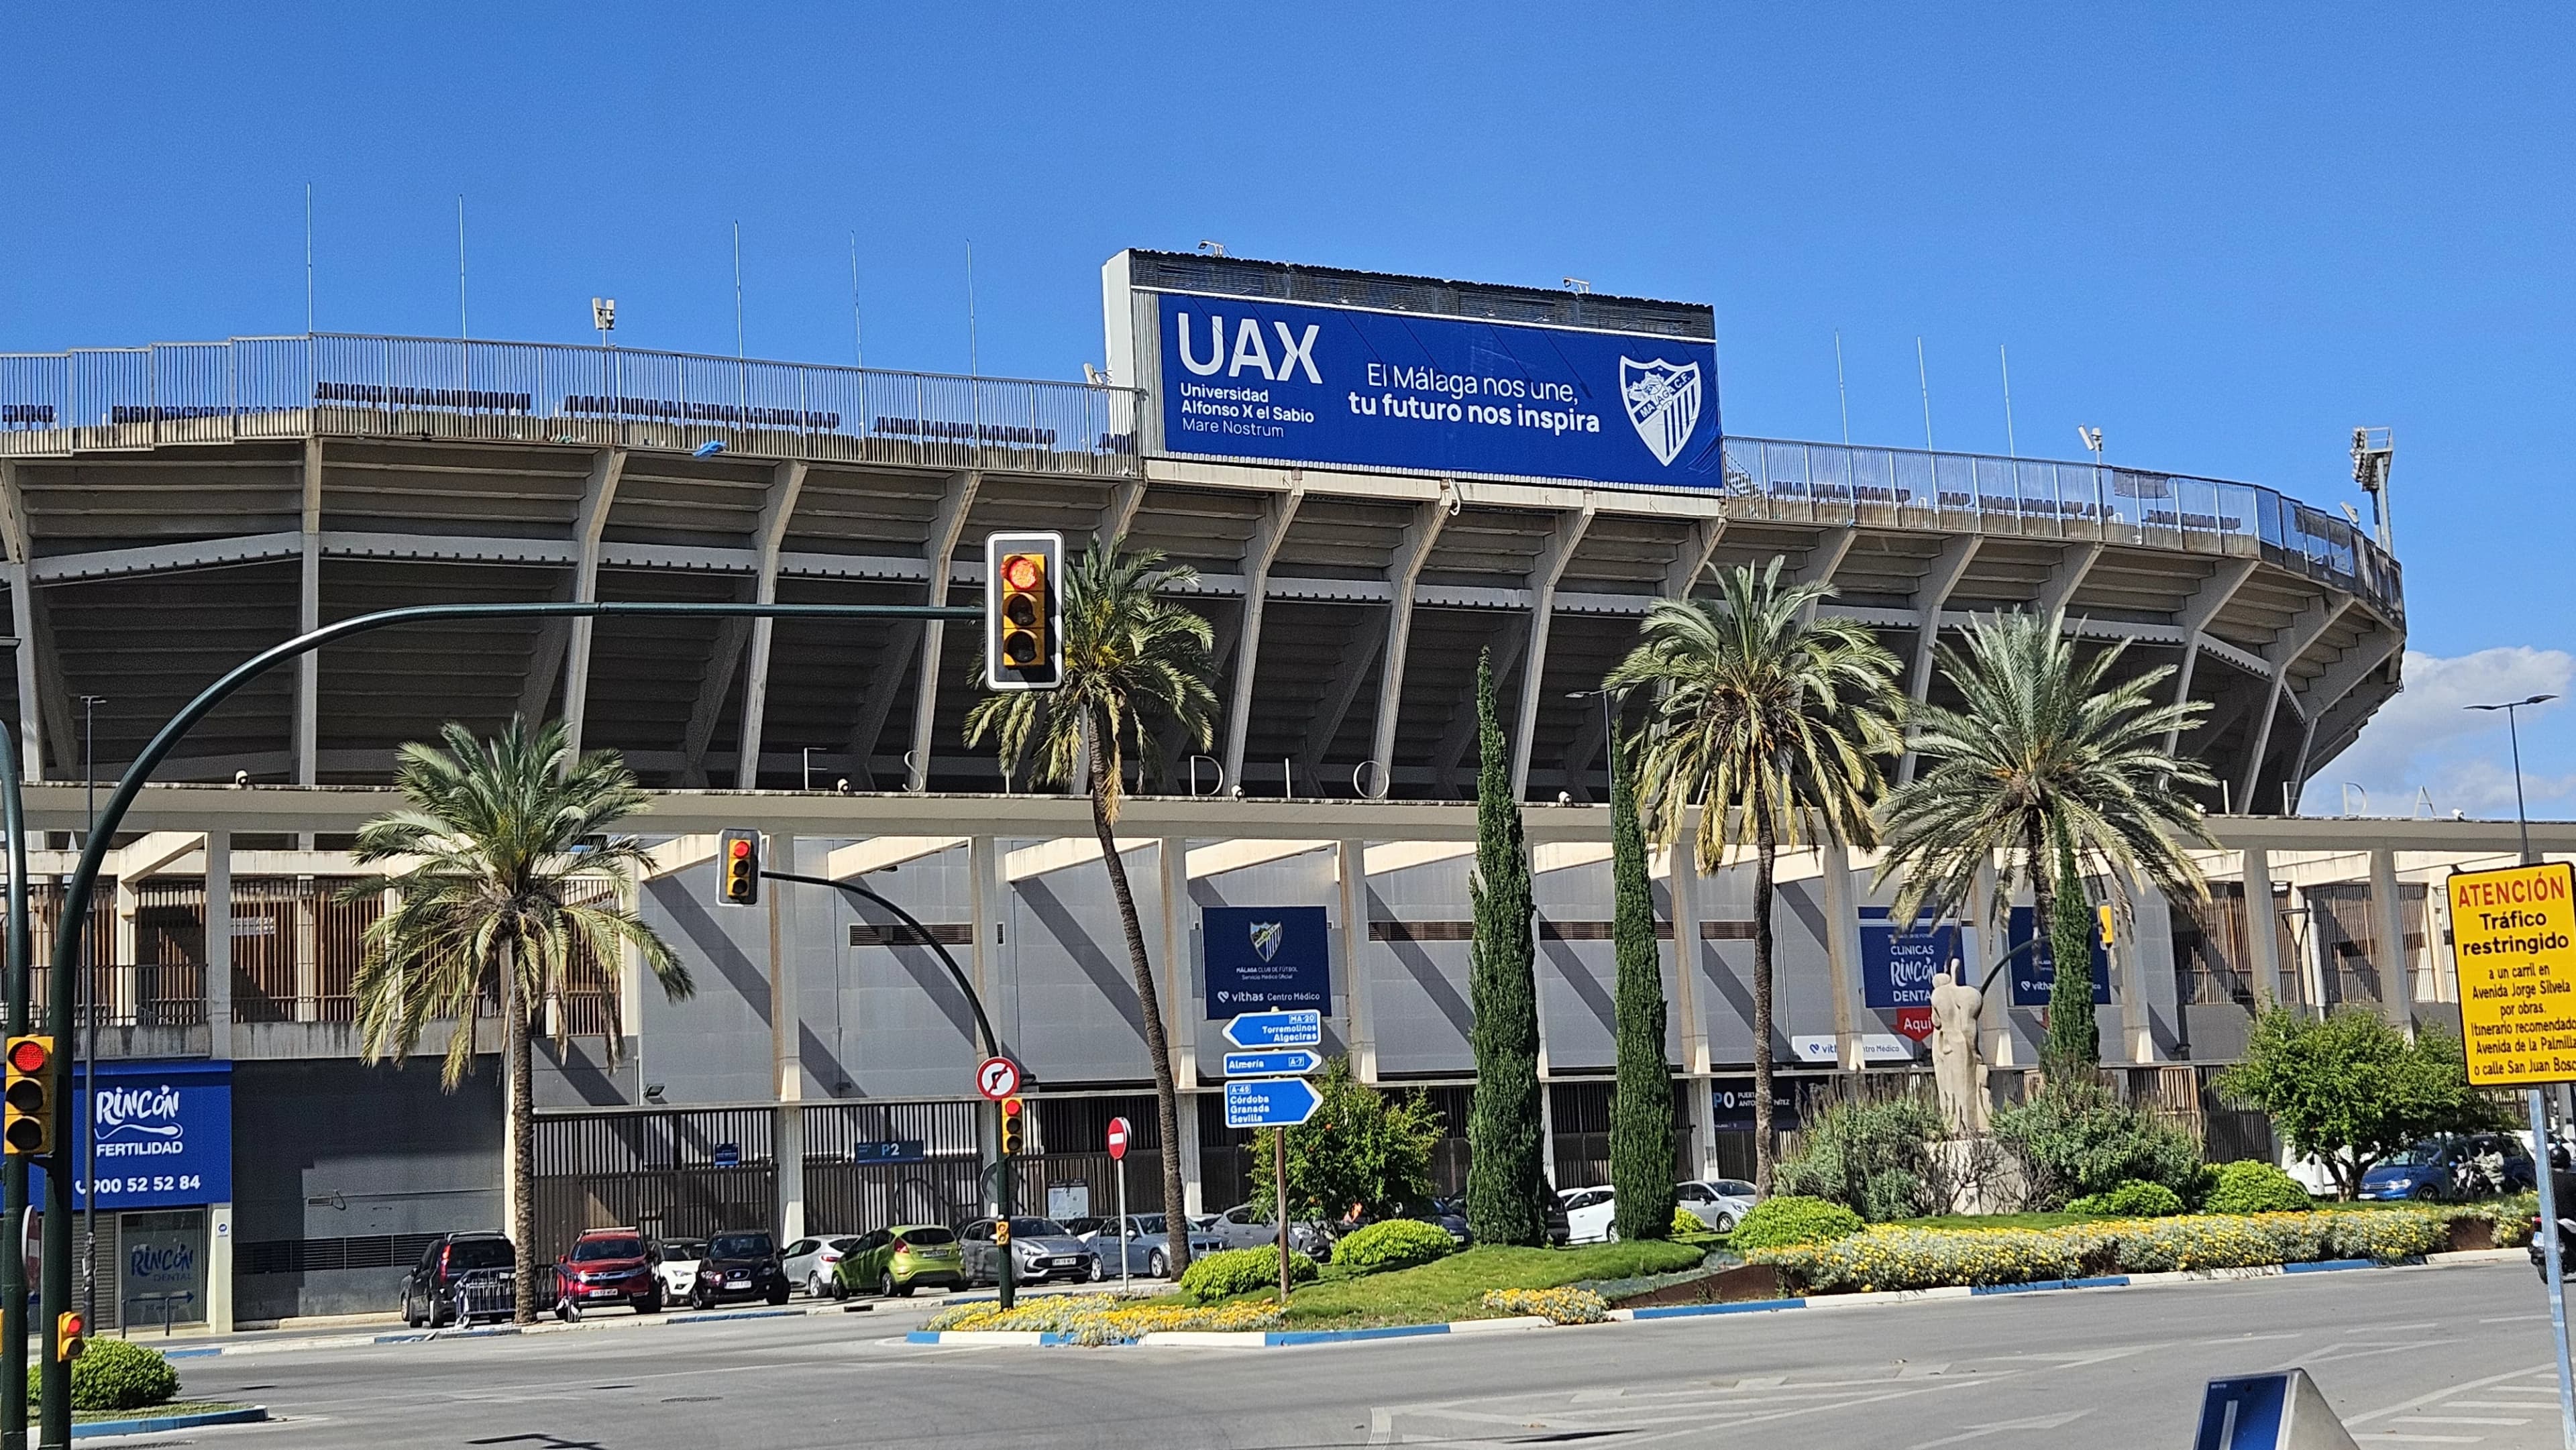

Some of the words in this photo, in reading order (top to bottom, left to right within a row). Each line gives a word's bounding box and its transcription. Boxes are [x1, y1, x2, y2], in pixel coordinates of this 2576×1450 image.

[1178, 313, 1323, 384] UAX
[1181, 382, 1269, 402] Universidad
[1368, 363, 1387, 387] El
[1393, 365, 1477, 400] Málaga
[1483, 377, 1525, 398] nos
[1531, 382, 1578, 405] une,
[1181, 400, 1239, 417] Alfonso
[1242, 404, 1253, 419] X
[1256, 406, 1270, 420] el
[1273, 406, 1314, 423] Sabio
[1348, 392, 1377, 415] tu
[1383, 393, 1462, 422] futuro
[1468, 404, 1511, 425] nos
[1517, 404, 1600, 436] inspira
[1182, 417, 1219, 433] Mare
[1223, 421, 1284, 437] Nostrum
[2459, 872, 2565, 908] ATENCIÓN
[2479, 910, 2547, 931] Tráfico
[1890, 944, 1934, 955] CLINICAS
[2463, 932, 2569, 956] restringido
[1890, 956, 1937, 987] RINCÓN
[2489, 969, 2494, 980] a
[2497, 967, 2509, 979] un
[2512, 962, 2536, 979] carril
[2538, 964, 2550, 977] en
[1232, 991, 1263, 1003] vithas
[1267, 993, 1293, 1001] Centro
[1293, 991, 1320, 1001] Médico
[1892, 990, 1931, 1002] DENTA
[2473, 984, 2508, 1000] Avenida
[2512, 983, 2536, 999] Jorge
[2540, 979, 2571, 995] Silvela
[2500, 1005, 2514, 1020] por
[2518, 1001, 2546, 1015] obras.
[1262, 1025, 1317, 1034] Torremolinos
[2471, 1020, 2512, 1037] Itinerario
[2515, 1016, 2576, 1034] recomendado
[1273, 1032, 1317, 1042] Algeciras
[2476, 1039, 2512, 1056] Avenida
[2515, 1038, 2526, 1052] de
[2528, 1037, 2537, 1052] la
[2540, 1035, 2576, 1052] Palmilla
[1228, 1059, 1265, 1070] Almería
[2474, 1065, 2480, 1076] o
[2482, 1062, 2505, 1076] calle
[2508, 1060, 2526, 1074] San
[2530, 1058, 2551, 1073] Juan
[96, 1084, 179, 1125] RINCÓN
[1230, 1095, 1270, 1104] Córdoba
[1230, 1104, 1270, 1113] Granada
[1230, 1113, 1263, 1123] Sevilla
[96, 1141, 182, 1157] FERTILIDAD
[881, 1143, 900, 1156] P2
[127, 1177, 148, 1192] 52
[153, 1176, 174, 1191] 52
[179, 1174, 201, 1190] 84
